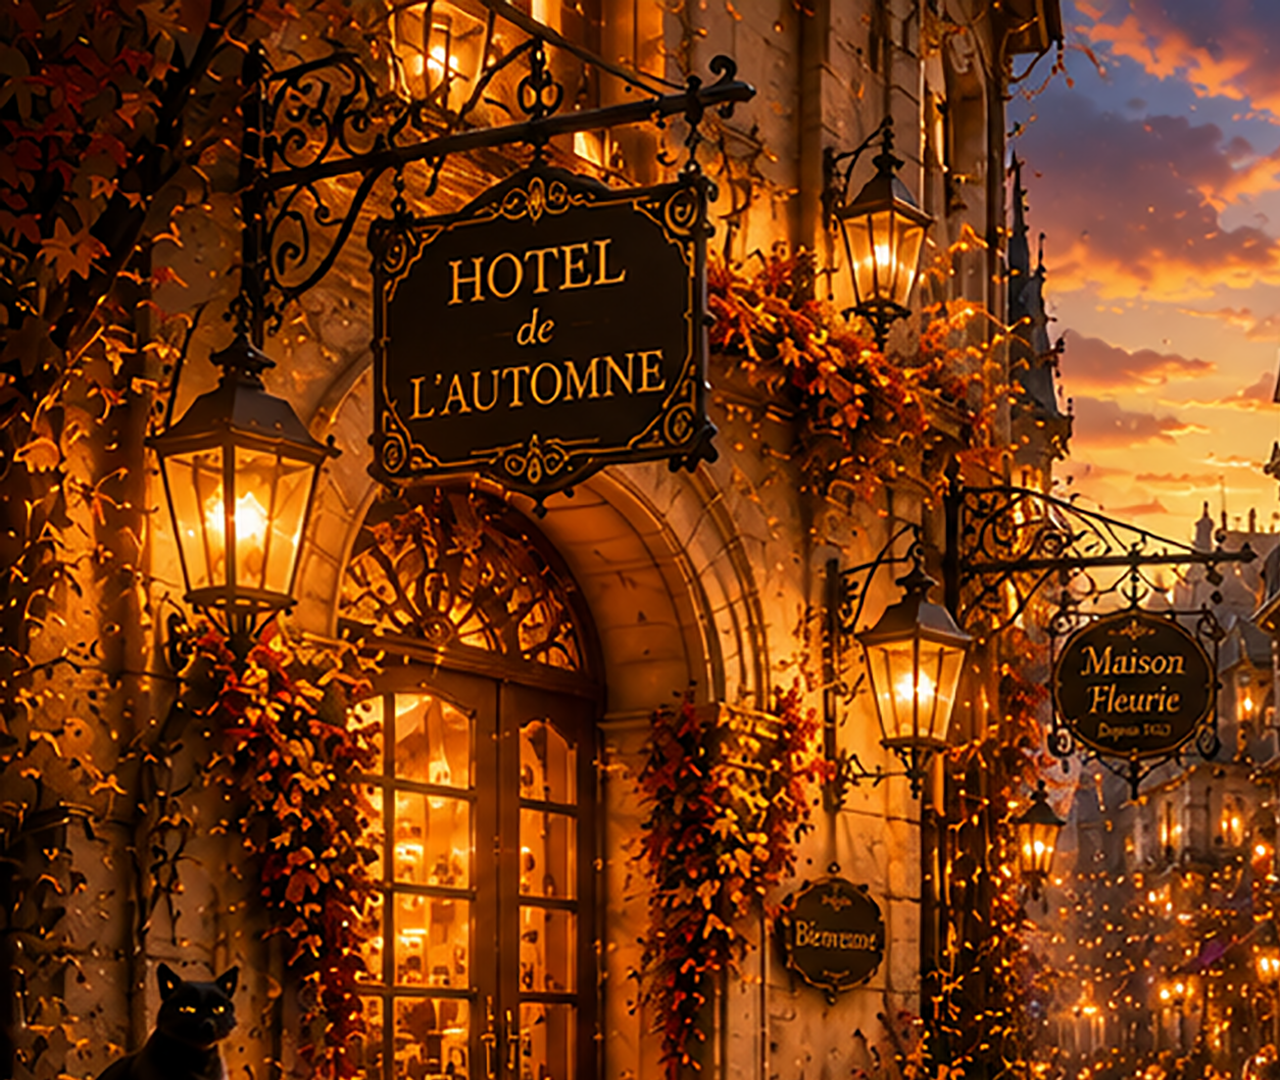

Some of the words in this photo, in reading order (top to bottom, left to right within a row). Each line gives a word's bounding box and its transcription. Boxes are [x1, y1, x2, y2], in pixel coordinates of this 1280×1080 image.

[447, 238, 627, 306] HOTEL
[516, 307, 555, 346] de
[408, 349, 667, 421] L'AUTOMNE
[1080, 645, 1185, 676] Maison
[1087, 683, 1181, 714] Fleurie
